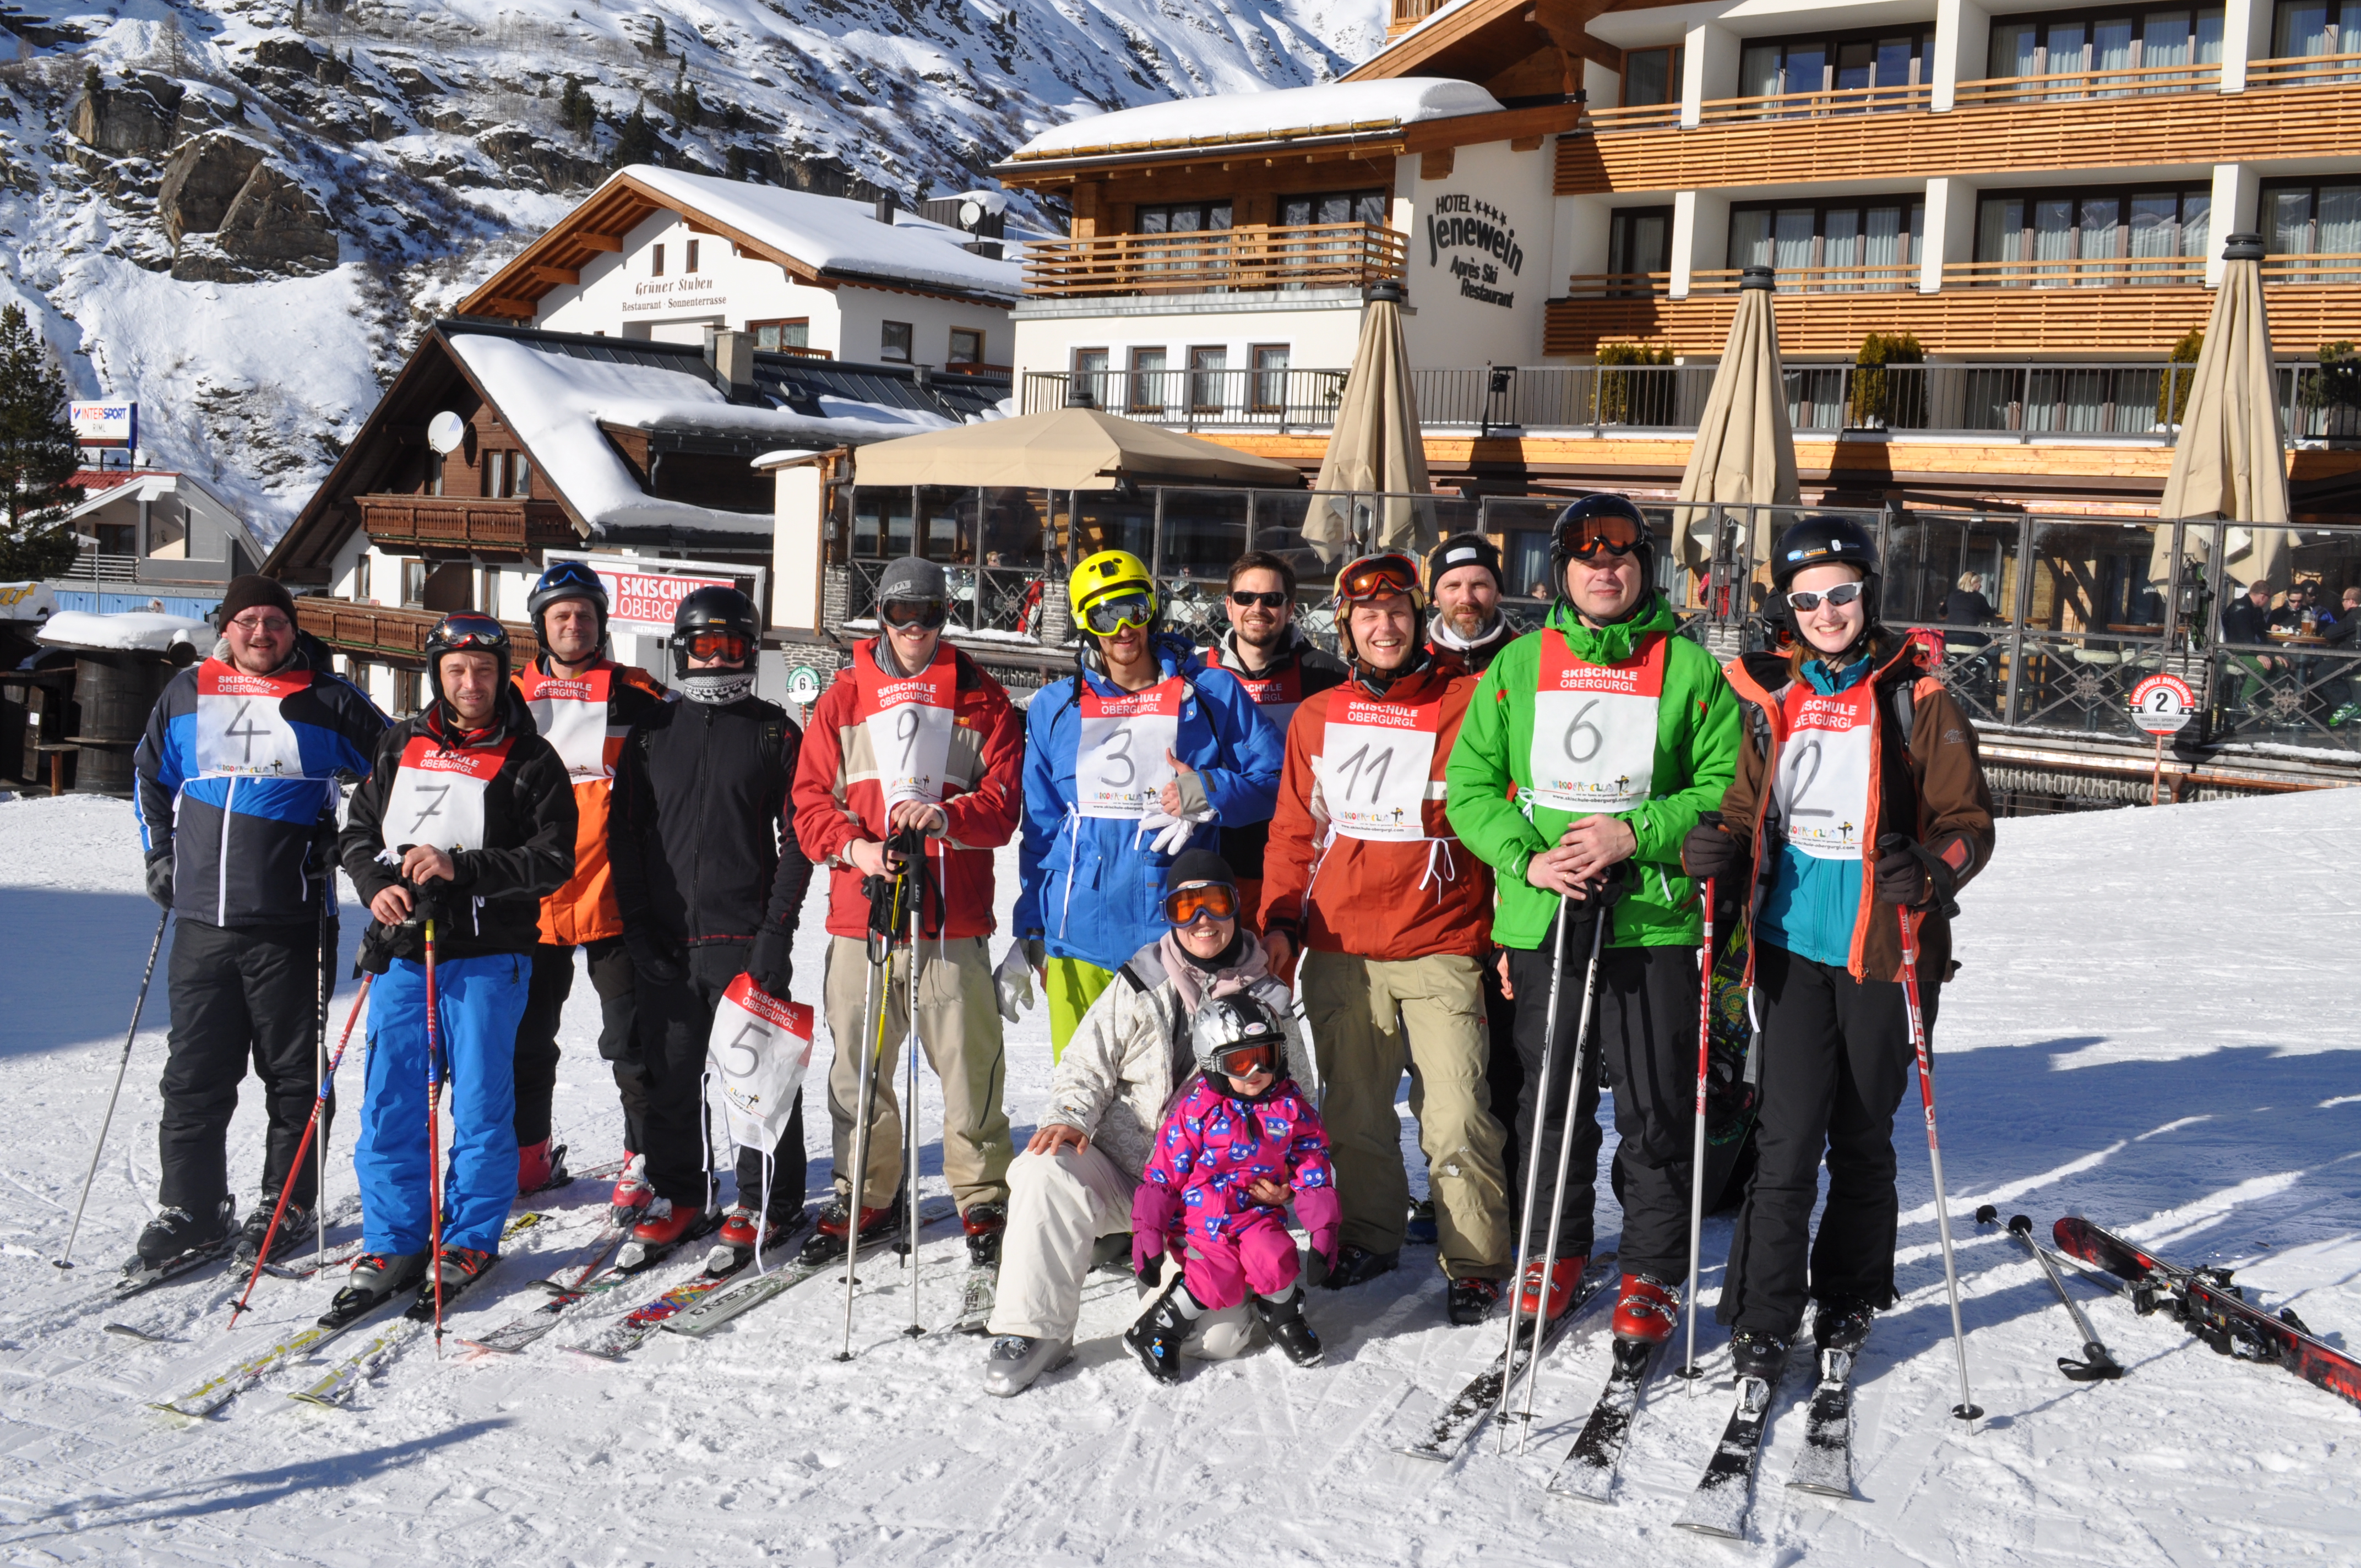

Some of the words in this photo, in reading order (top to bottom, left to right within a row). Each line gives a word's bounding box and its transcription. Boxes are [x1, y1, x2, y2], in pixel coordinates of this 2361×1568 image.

[1436, 195, 1471, 215] HOTEL
[1427, 214, 1523, 276] Jenewein
[1450, 255, 1480, 279] Après
[1482, 265, 1499, 284] Ski
[635, 281, 674, 297] Grüner
[678, 277, 712, 291] Stuben
[1460, 278, 1514, 308] Restaurant
[622, 300, 661, 311] Restaurant
[668, 296, 727, 308] Sonnenterrasse
[82, 407, 127, 420] INTERSPORT
[93, 423, 106, 432] RIML
[218, 676, 280, 691] SKISCHULE
[799, 678, 806, 690] 6
[1562, 668, 1638, 680] SKISCHULE
[217, 684, 270, 694] OBERGURGL
[534, 688, 591, 700] OBERGURGL
[877, 682, 937, 698] SKISCHULE
[1560, 679, 1636, 692] OBERGURGL
[2132, 677, 2161, 703] SKISCHULE
[2162, 677, 2191, 704] OBERGURGL
[879, 693, 936, 708] OBERGURGL
[1251, 693, 1283, 702] GURGL
[1799, 700, 1857, 715] ISCHULE
[2155, 692, 2168, 712] 2
[1101, 703, 1159, 715] OBERGURGL
[1347, 711, 1416, 727] OBERGURGL
[1348, 702, 1418, 717] SKISCHULE
[1794, 714, 1852, 728] BERGURGL
[225, 700, 271, 764] 4
[897, 709, 920, 770] 9
[1563, 699, 1603, 764] 6
[420, 759, 472, 774] OBERGURGL
[1098, 728, 1135, 787] 3
[1337, 743, 1394, 805] 11
[1790, 740, 1835, 818] 2
[410, 785, 450, 834] 7
[1587, 958, 1598, 998] LEKI
[742, 997, 795, 1030] OBERGURGL
[748, 987, 798, 1020] SKISCHULE
[724, 1021, 773, 1078] 5
[1912, 1005, 1929, 1078] SCOTT
